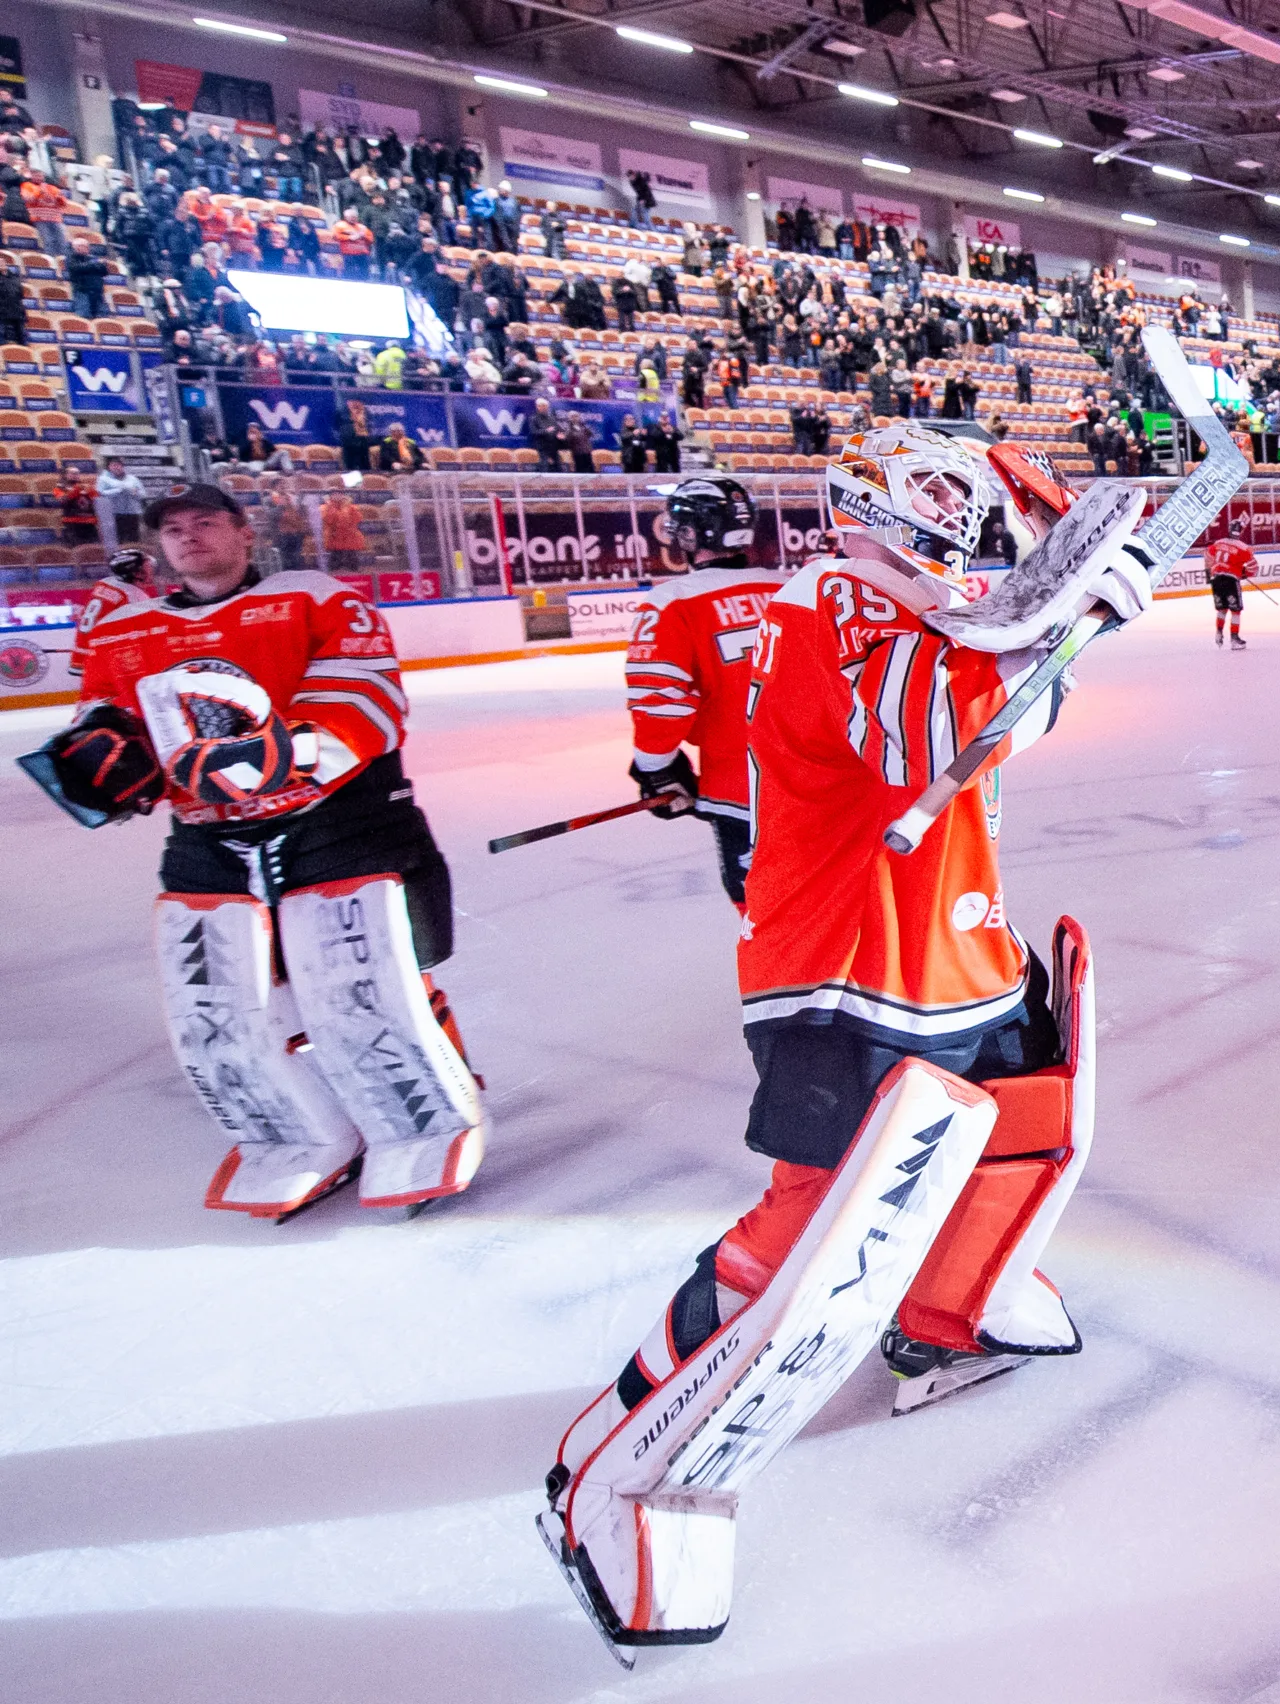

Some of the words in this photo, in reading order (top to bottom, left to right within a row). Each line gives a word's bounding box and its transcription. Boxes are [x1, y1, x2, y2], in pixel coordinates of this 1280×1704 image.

[977, 220, 1003, 240] ICA
[1059, 491, 1131, 578] BAUER
[1149, 466, 1230, 556] BAUER
[614, 534, 648, 559] in
[943, 551, 970, 581] 3
[821, 575, 899, 630] 35
[633, 1326, 741, 1462] SUPREME
